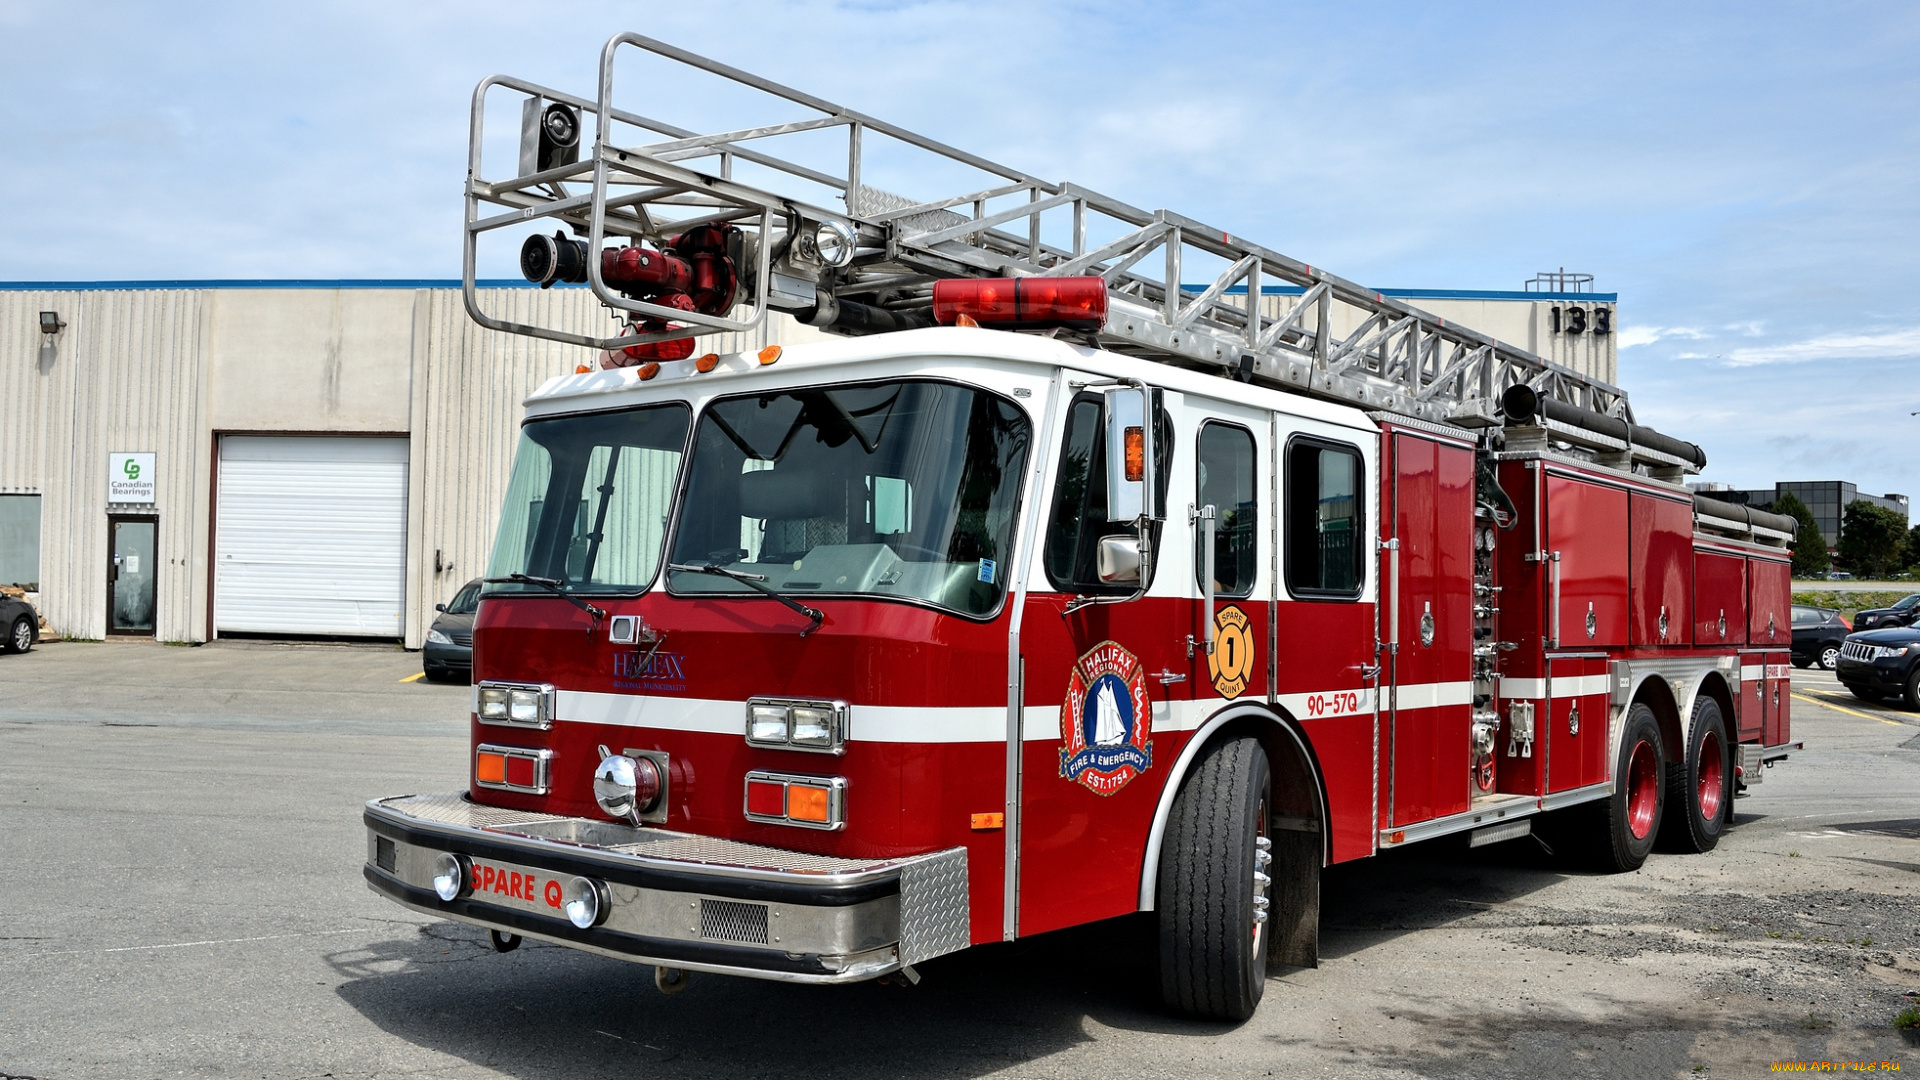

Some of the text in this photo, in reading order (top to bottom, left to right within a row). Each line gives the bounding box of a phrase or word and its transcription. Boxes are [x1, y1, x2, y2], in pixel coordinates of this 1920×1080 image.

[1551, 307, 1610, 334] 133
[112, 488, 151, 497] Bearings
[1221, 611, 1243, 625] SPARE
[1085, 648, 1132, 672] HALIFAX
[1226, 637, 1235, 668] 1
[1090, 662, 1126, 680] REGIONAL
[1220, 682, 1241, 694] QUINT
[1307, 692, 1358, 716] 90-57Q
[1069, 751, 1145, 775] FIRE & EMERGENCY
[1087, 769, 1128, 790] EST.1754
[470, 863, 563, 909] SPARE Q
